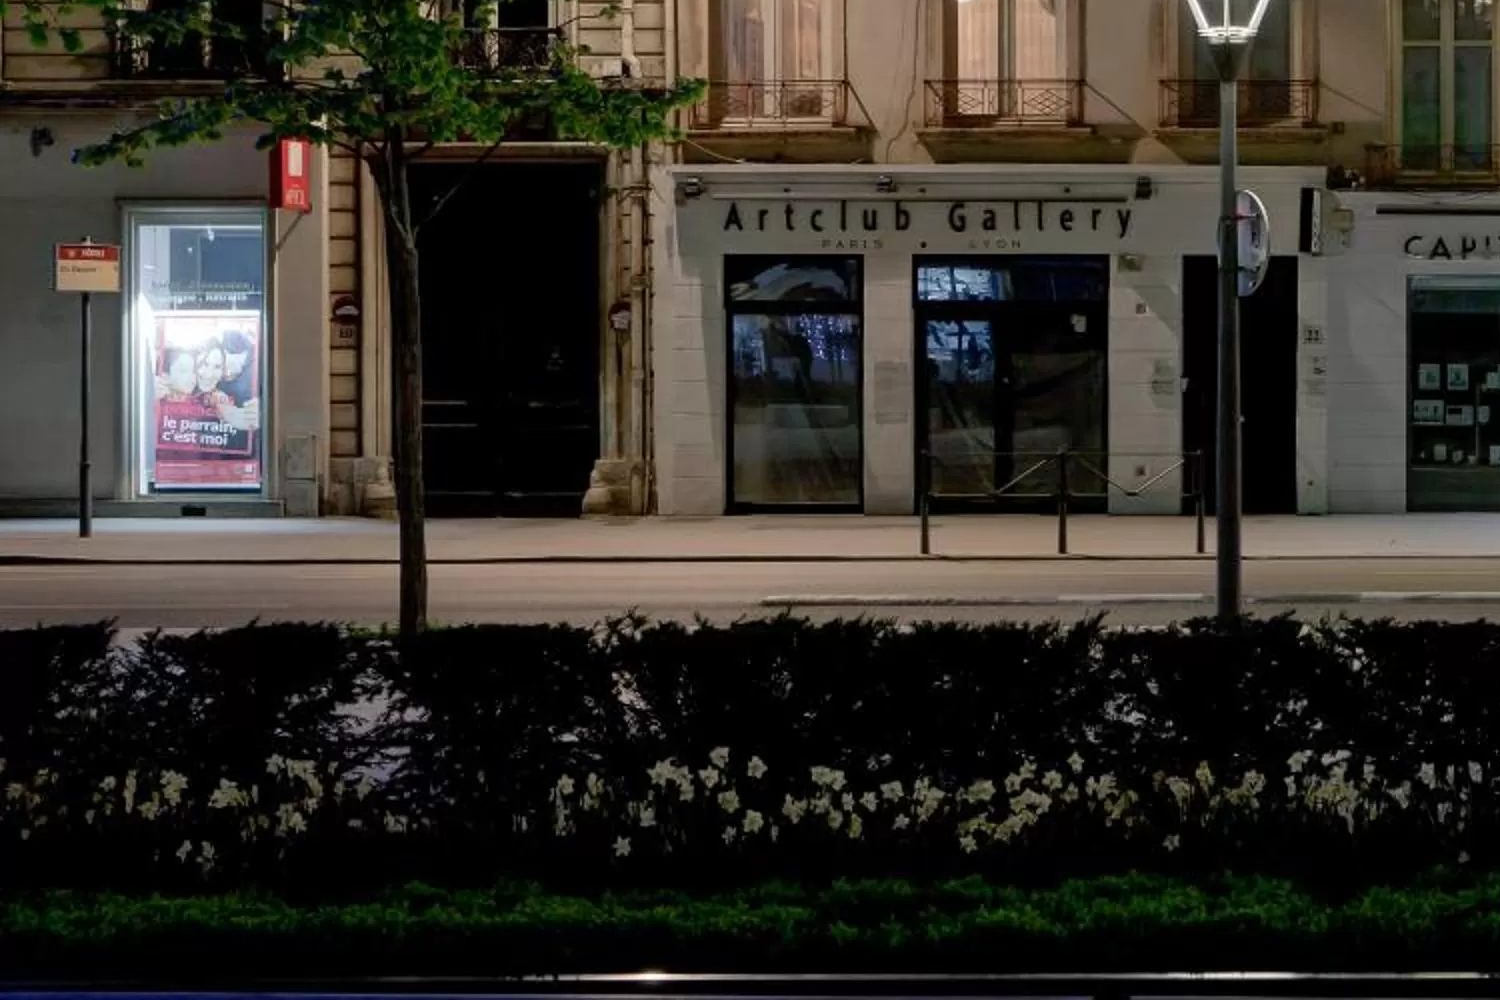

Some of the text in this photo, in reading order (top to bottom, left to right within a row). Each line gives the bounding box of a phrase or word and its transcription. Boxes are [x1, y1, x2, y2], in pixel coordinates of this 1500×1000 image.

[723, 200, 1131, 239] Artclub Gallery
[821, 239, 1023, 249] PARIS LYON
[163, 416, 237, 436] le parrain,
[201, 433, 229, 446] moi
